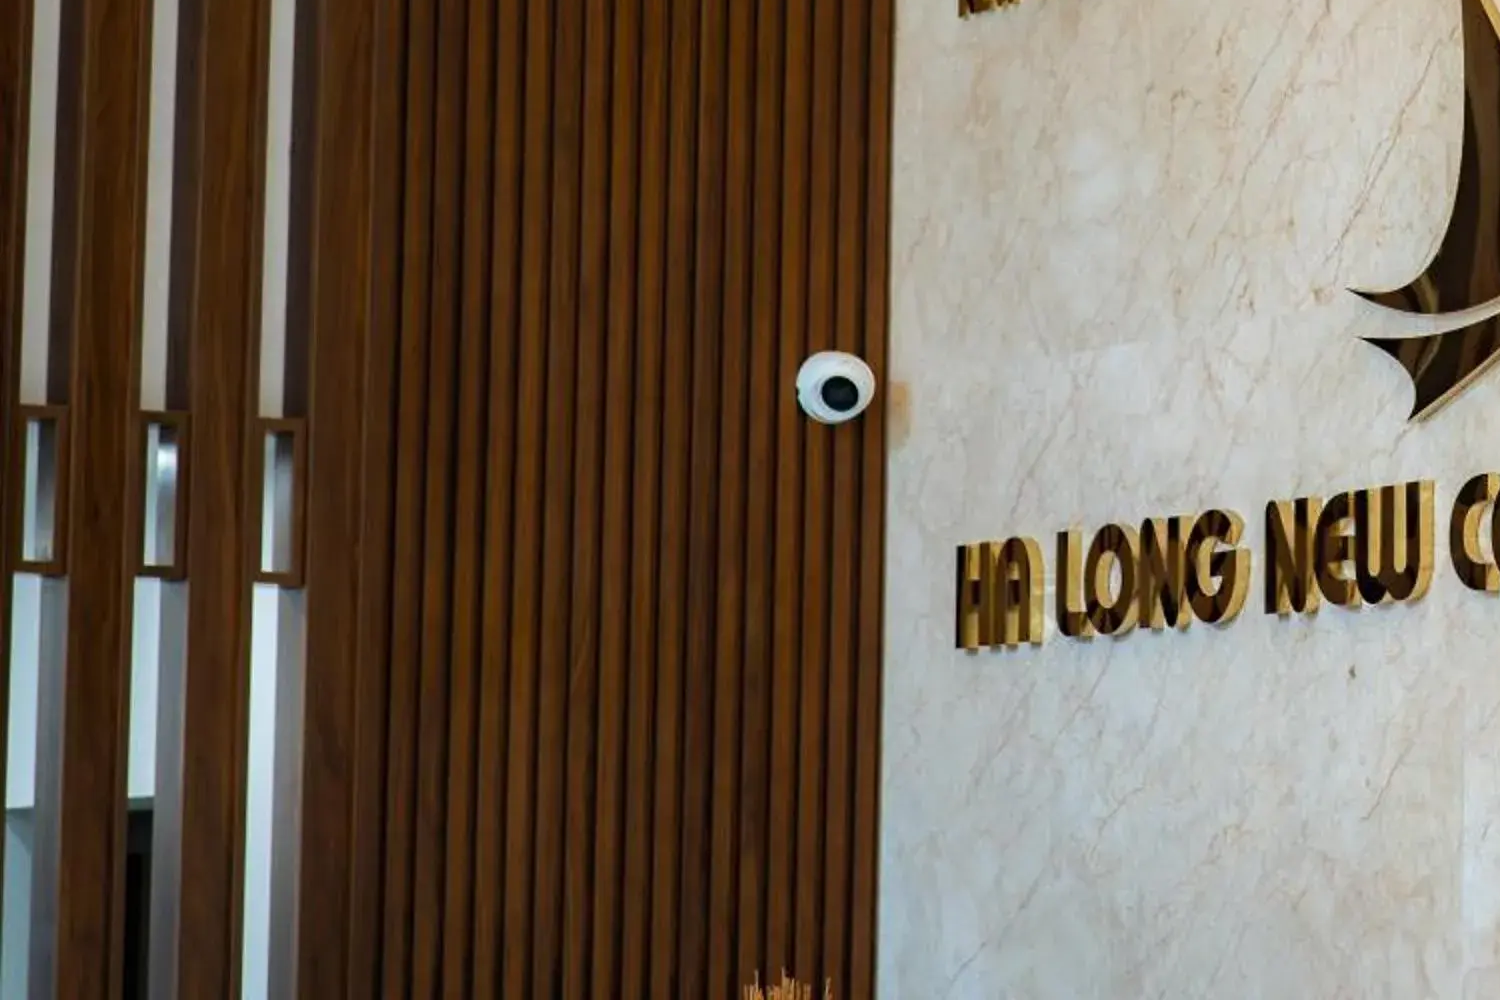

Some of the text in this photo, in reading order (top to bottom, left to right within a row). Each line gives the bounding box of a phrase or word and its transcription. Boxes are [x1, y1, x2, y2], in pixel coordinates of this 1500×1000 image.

[955, 536, 1045, 652] HA
[1055, 507, 1251, 637] LONG
[1264, 479, 1436, 615] NEW
